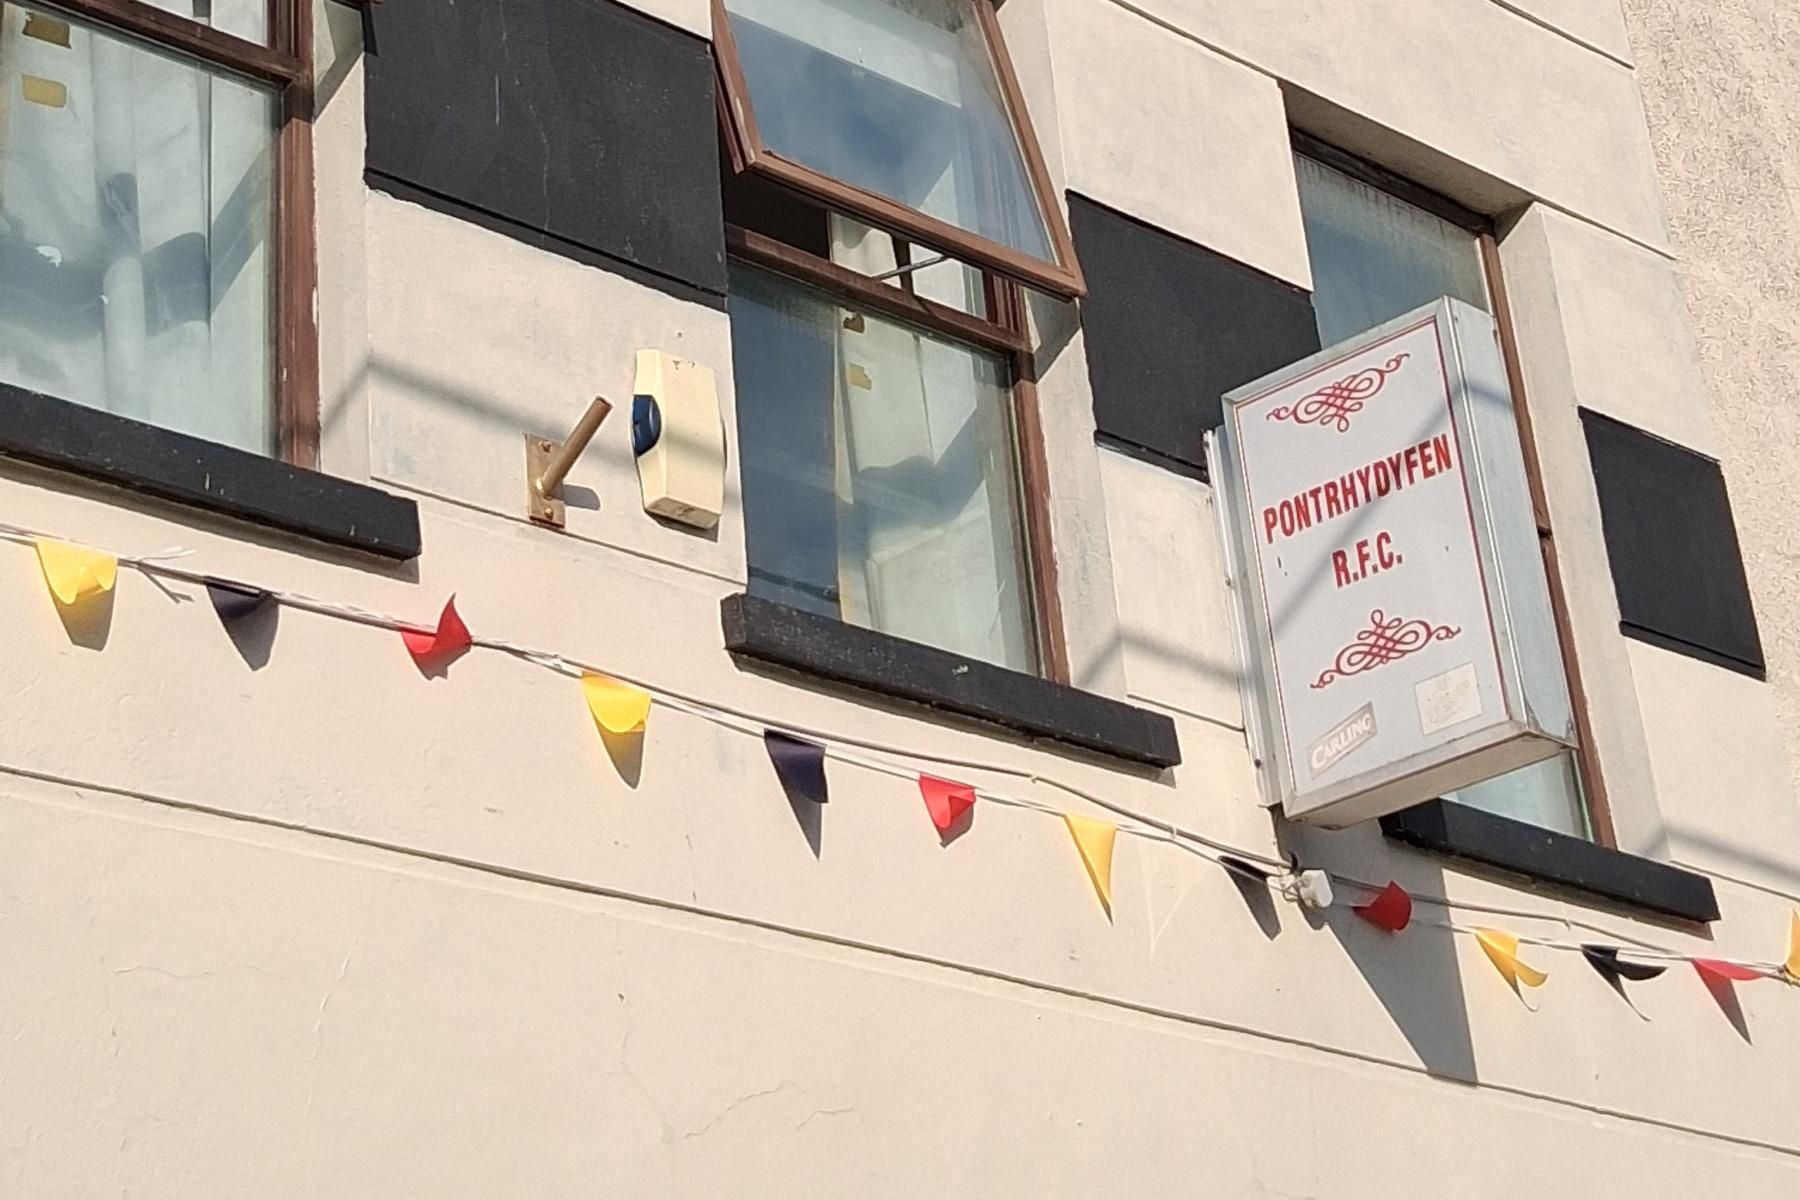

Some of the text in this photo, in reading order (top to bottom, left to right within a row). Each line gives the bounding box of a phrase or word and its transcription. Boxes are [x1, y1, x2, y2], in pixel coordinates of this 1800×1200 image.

[1263, 434, 1453, 544] PONTRHYDYFEN
[1332, 531, 1403, 587] R.F.C.
[1311, 713, 1372, 769] CARLING
